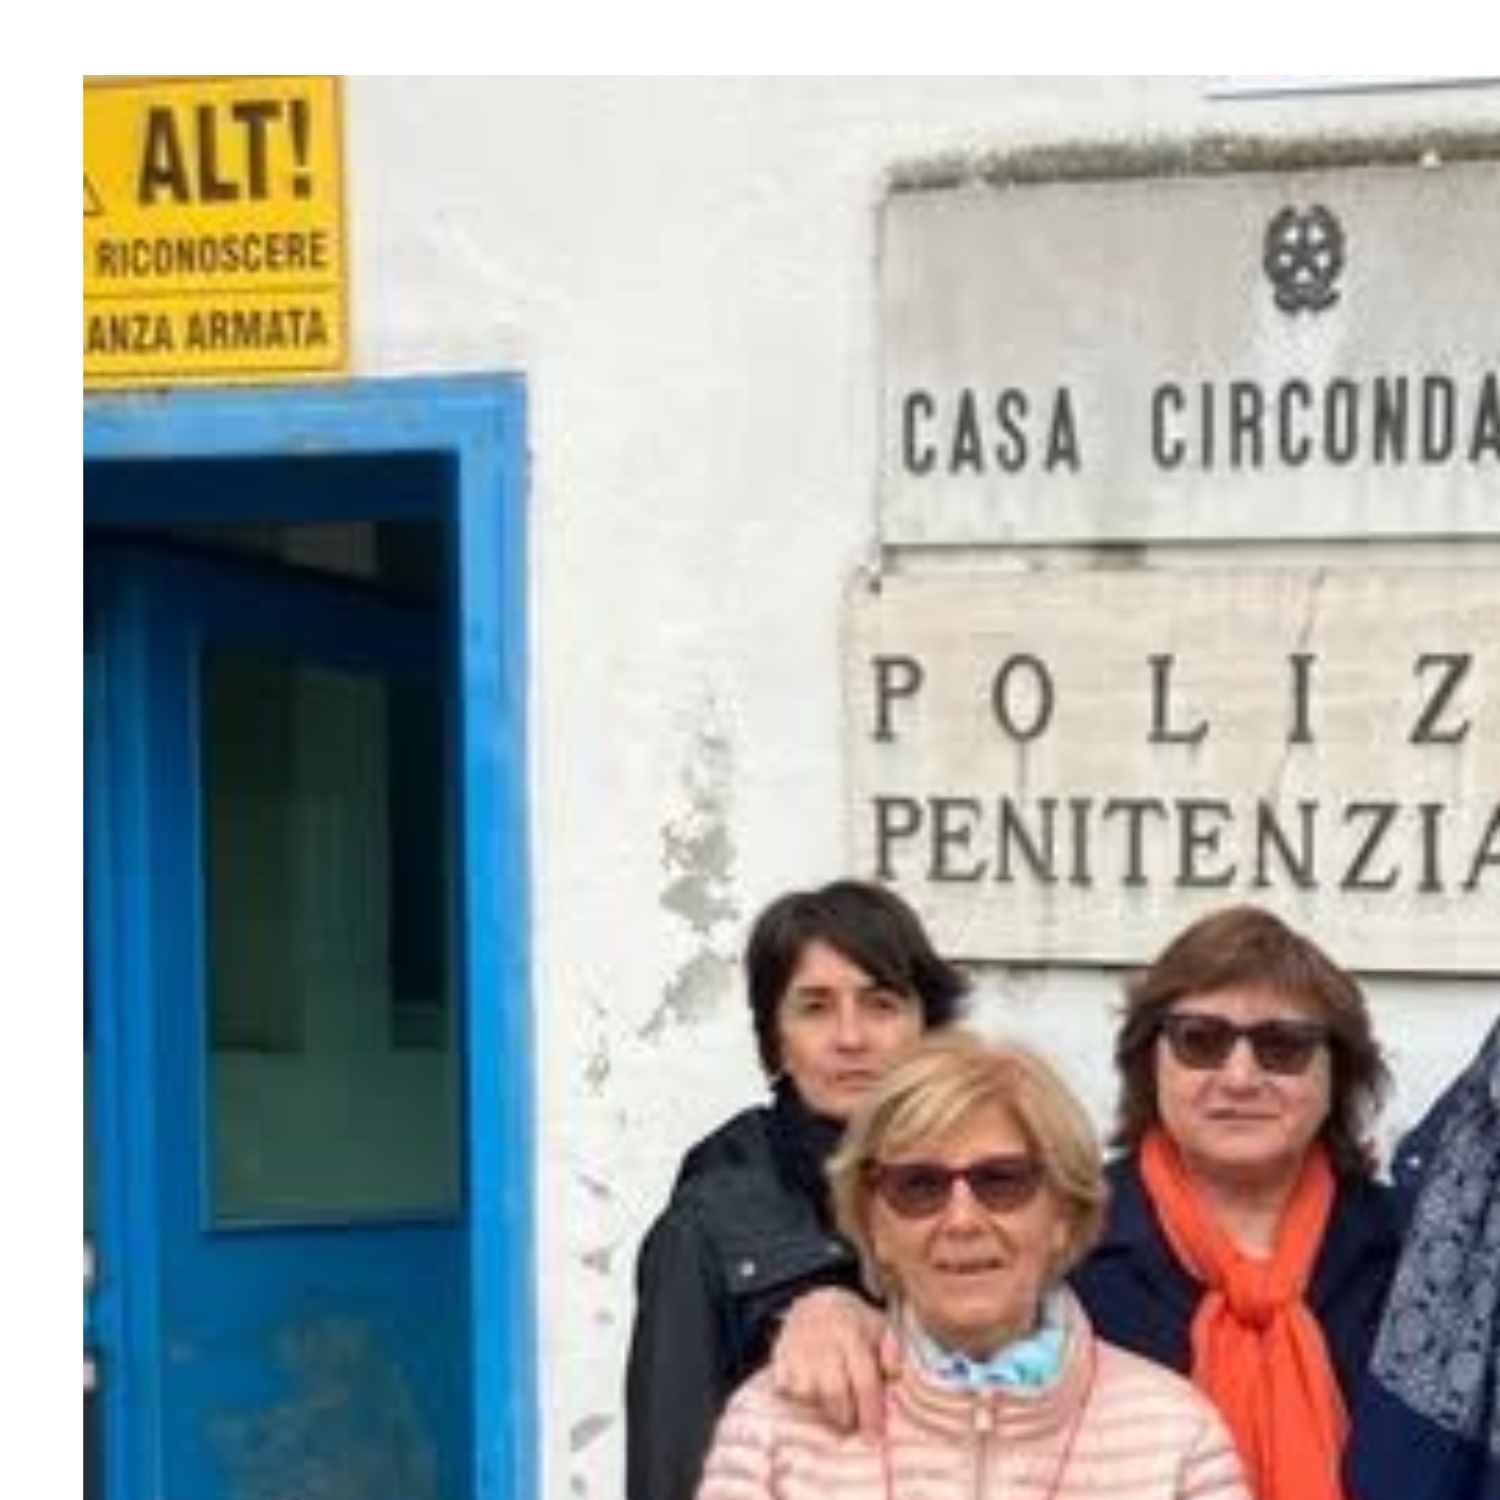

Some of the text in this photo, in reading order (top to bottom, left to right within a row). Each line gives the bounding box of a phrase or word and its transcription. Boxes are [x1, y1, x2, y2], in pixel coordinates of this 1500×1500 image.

[137, 99, 312, 205] ALT!
[95, 231, 328, 278] RICONOSCERE
[83, 308, 328, 354] ANZA ARMATA
[902, 387, 1082, 477] CASA
